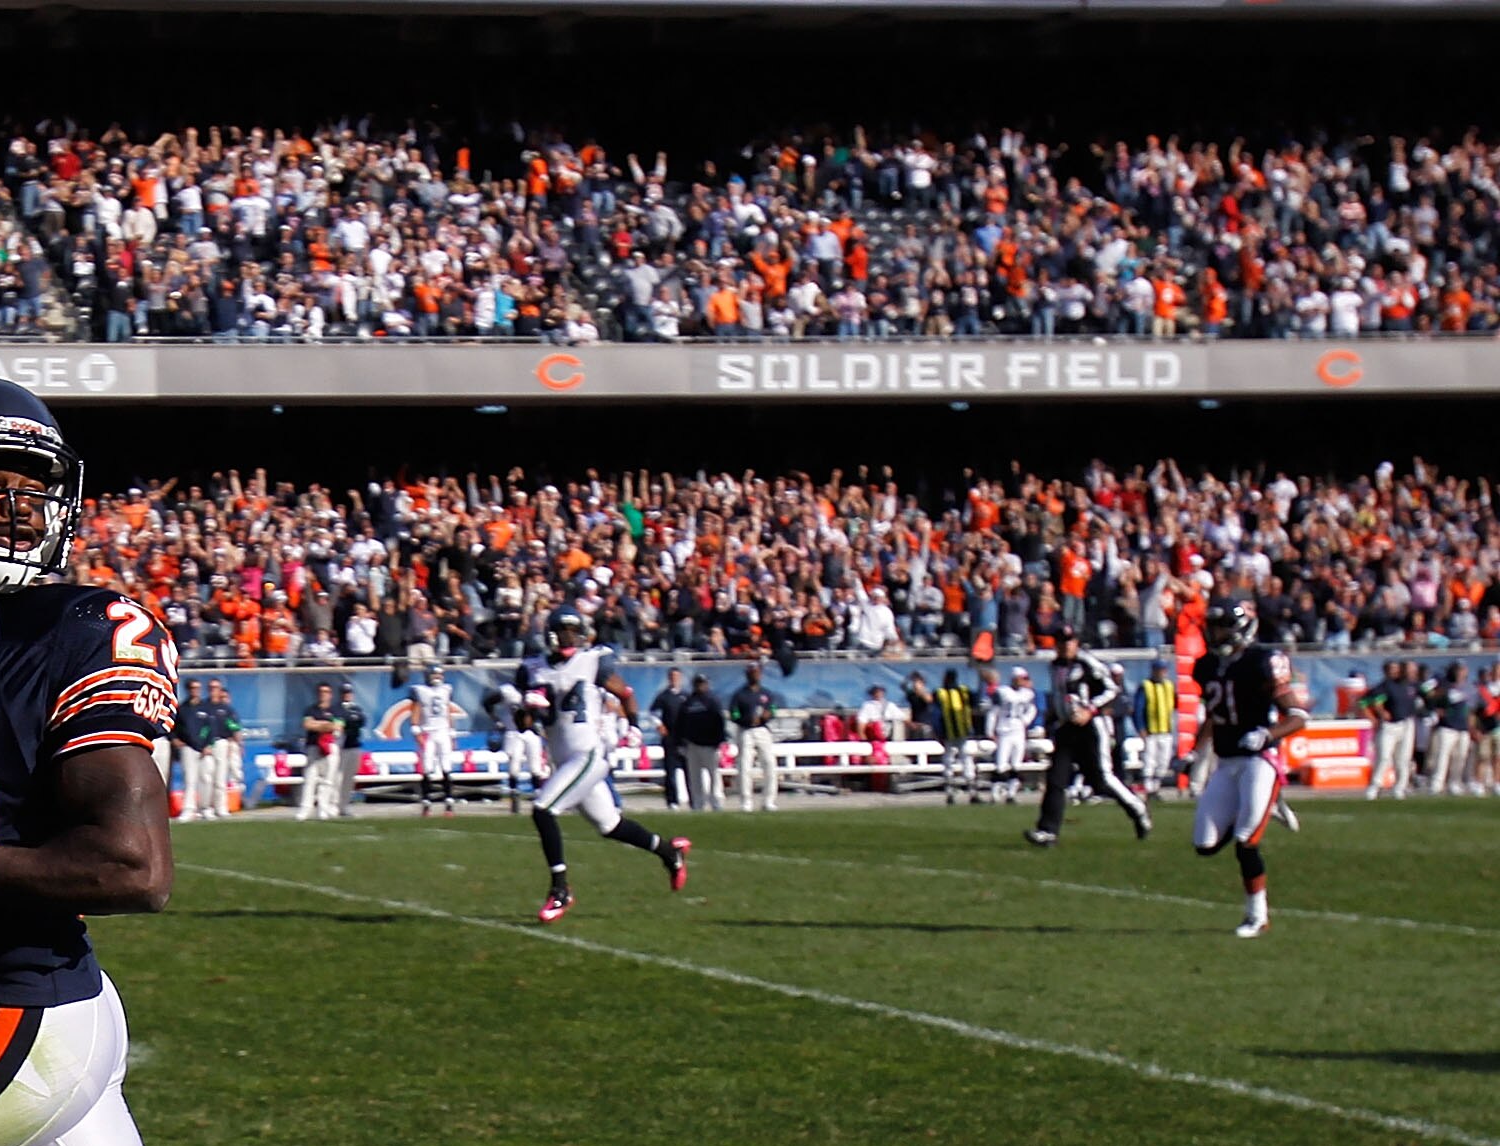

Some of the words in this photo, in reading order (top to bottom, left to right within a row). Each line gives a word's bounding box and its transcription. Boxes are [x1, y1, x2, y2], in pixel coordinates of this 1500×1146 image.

[717, 353, 985, 389] SOLDIER
[1007, 352, 1183, 389] FIELD
[1204, 680, 1239, 725] 21
